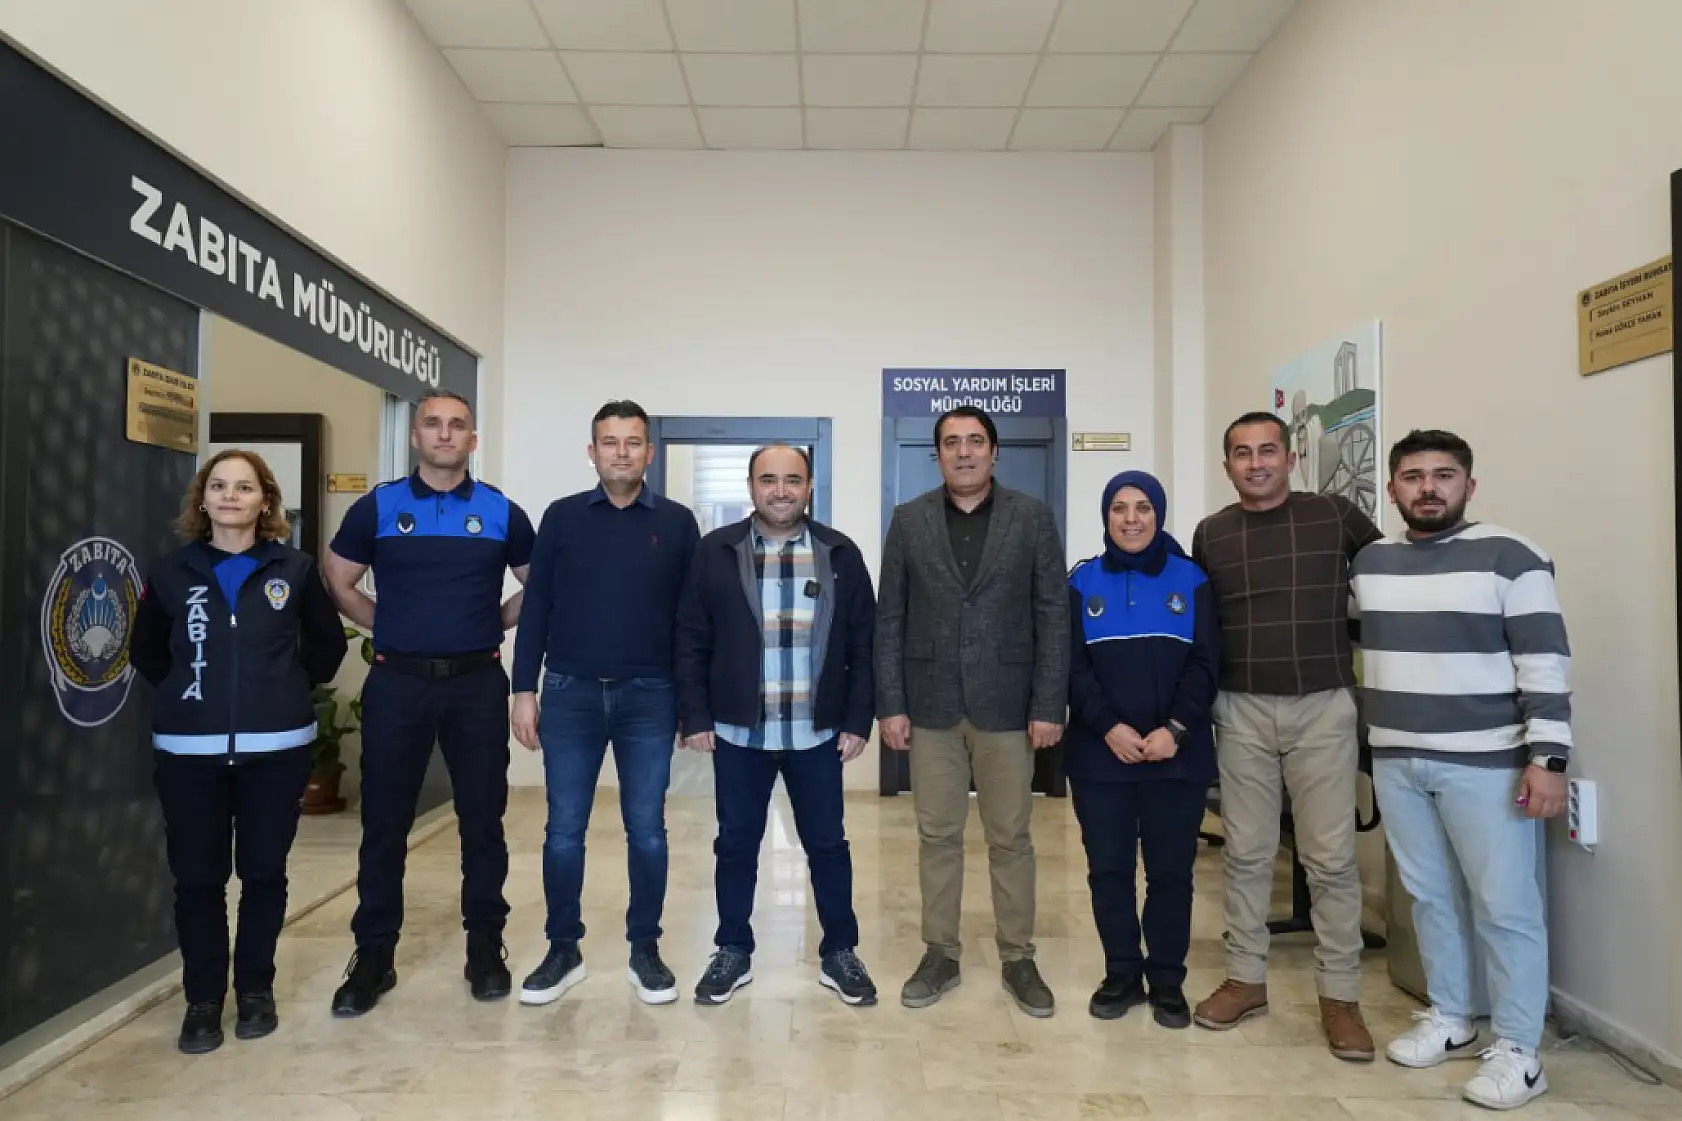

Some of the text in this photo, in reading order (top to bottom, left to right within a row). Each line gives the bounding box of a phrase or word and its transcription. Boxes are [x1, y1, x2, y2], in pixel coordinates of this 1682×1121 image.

[129, 175, 440, 388] ZABITA MÜDÜRLÜĞÜ
[893, 373, 1056, 395] SOSYAL YARDIM İŞLERİ
[69, 541, 127, 576] ZABITA
[181, 584, 210, 701] ZABITA
